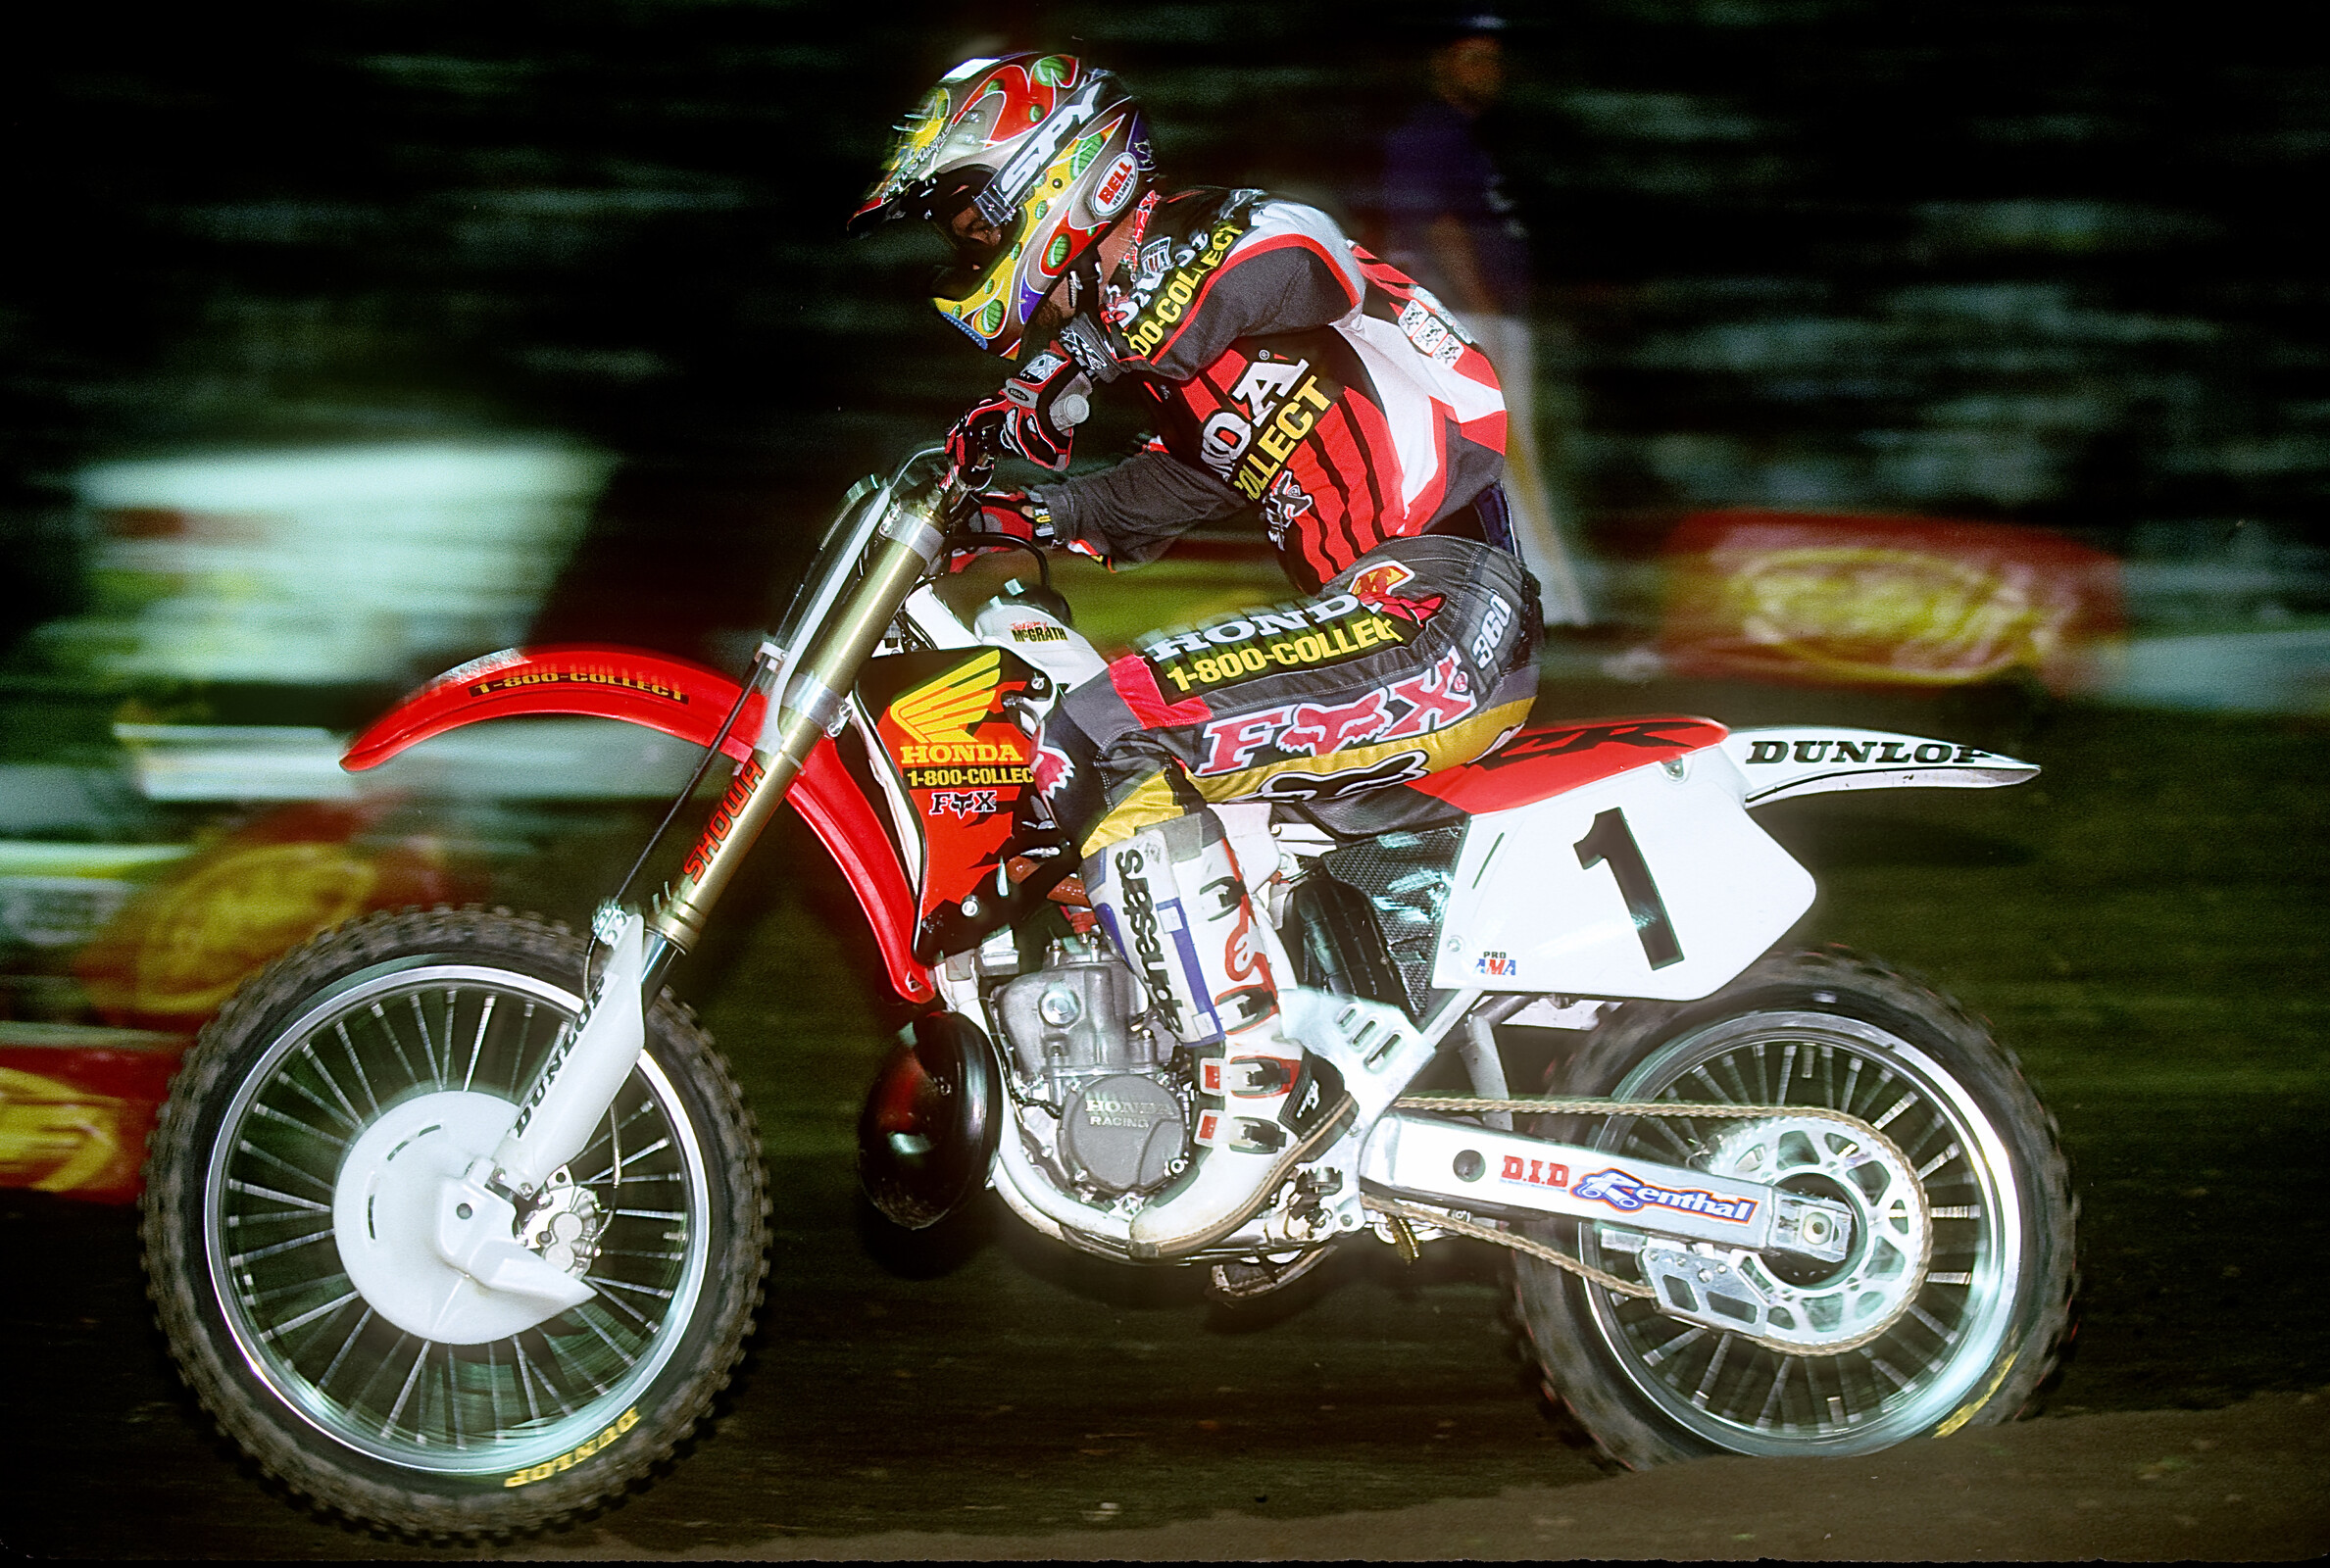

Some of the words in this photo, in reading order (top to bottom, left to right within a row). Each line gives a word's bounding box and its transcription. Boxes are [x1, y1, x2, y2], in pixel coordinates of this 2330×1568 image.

[1000, 81, 1102, 195] SPY
[1098, 162, 1132, 205] BELL
[1112, 173, 1134, 206] HELMETS
[1144, 594, 1383, 662] HOND
[1471, 594, 1512, 669] 360
[474, 671, 682, 702] 1-800-COLLECT
[900, 744, 1023, 764] HONDA
[683, 759, 766, 885] SHOWA
[1572, 807, 1684, 971] 1
[1473, 958, 1516, 976] AMA
[1483, 951, 1507, 959] PRO
[514, 976, 605, 1139] DUNLOP
[1084, 1100, 1174, 1115] HONDA
[1089, 1115, 1150, 1128] RACING
[1501, 1155, 1570, 1188] D.I.D
[1575, 1168, 1753, 1220] Renthal
[504, 1406, 642, 1488] DUNLOP
